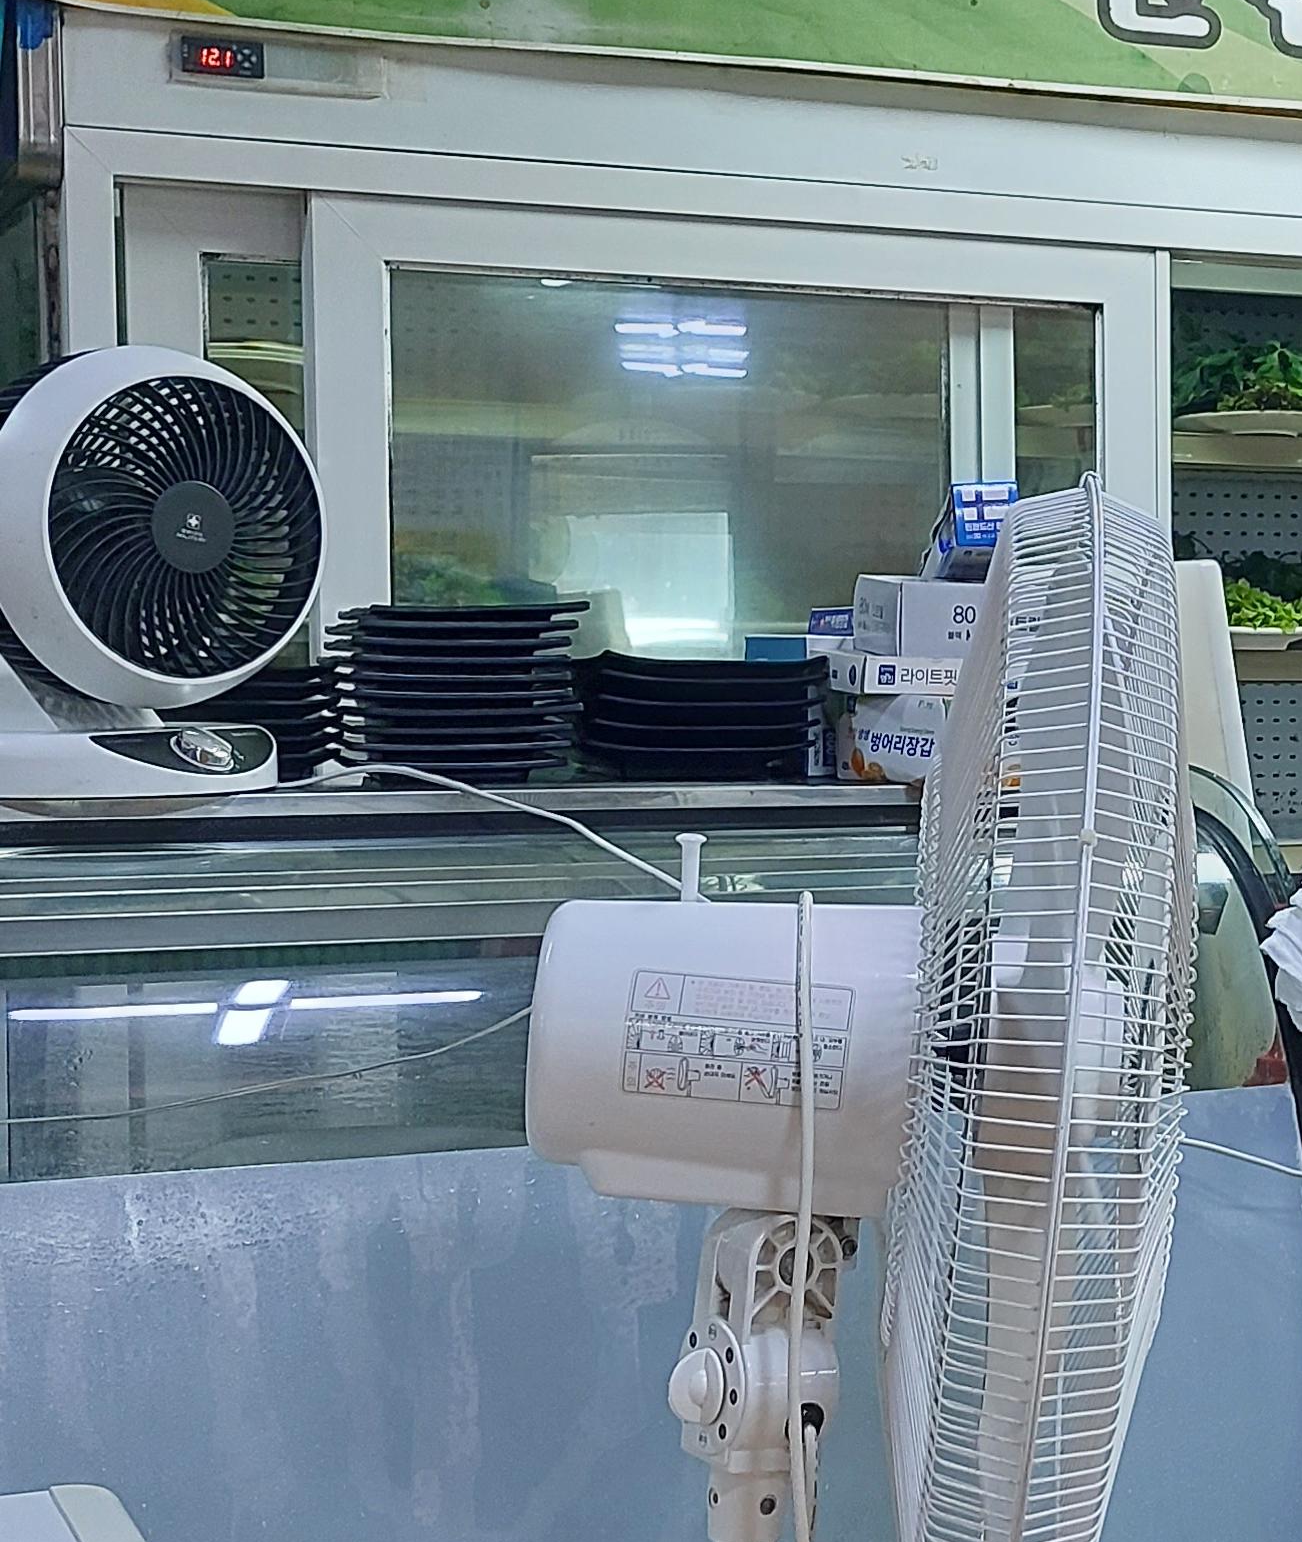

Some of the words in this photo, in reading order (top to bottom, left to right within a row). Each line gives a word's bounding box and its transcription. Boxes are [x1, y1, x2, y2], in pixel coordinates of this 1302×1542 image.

[953, 605, 977, 625] 80
[900, 667, 958, 686] 라이트핏
[870, 732, 935, 758] 벙어리장갑
